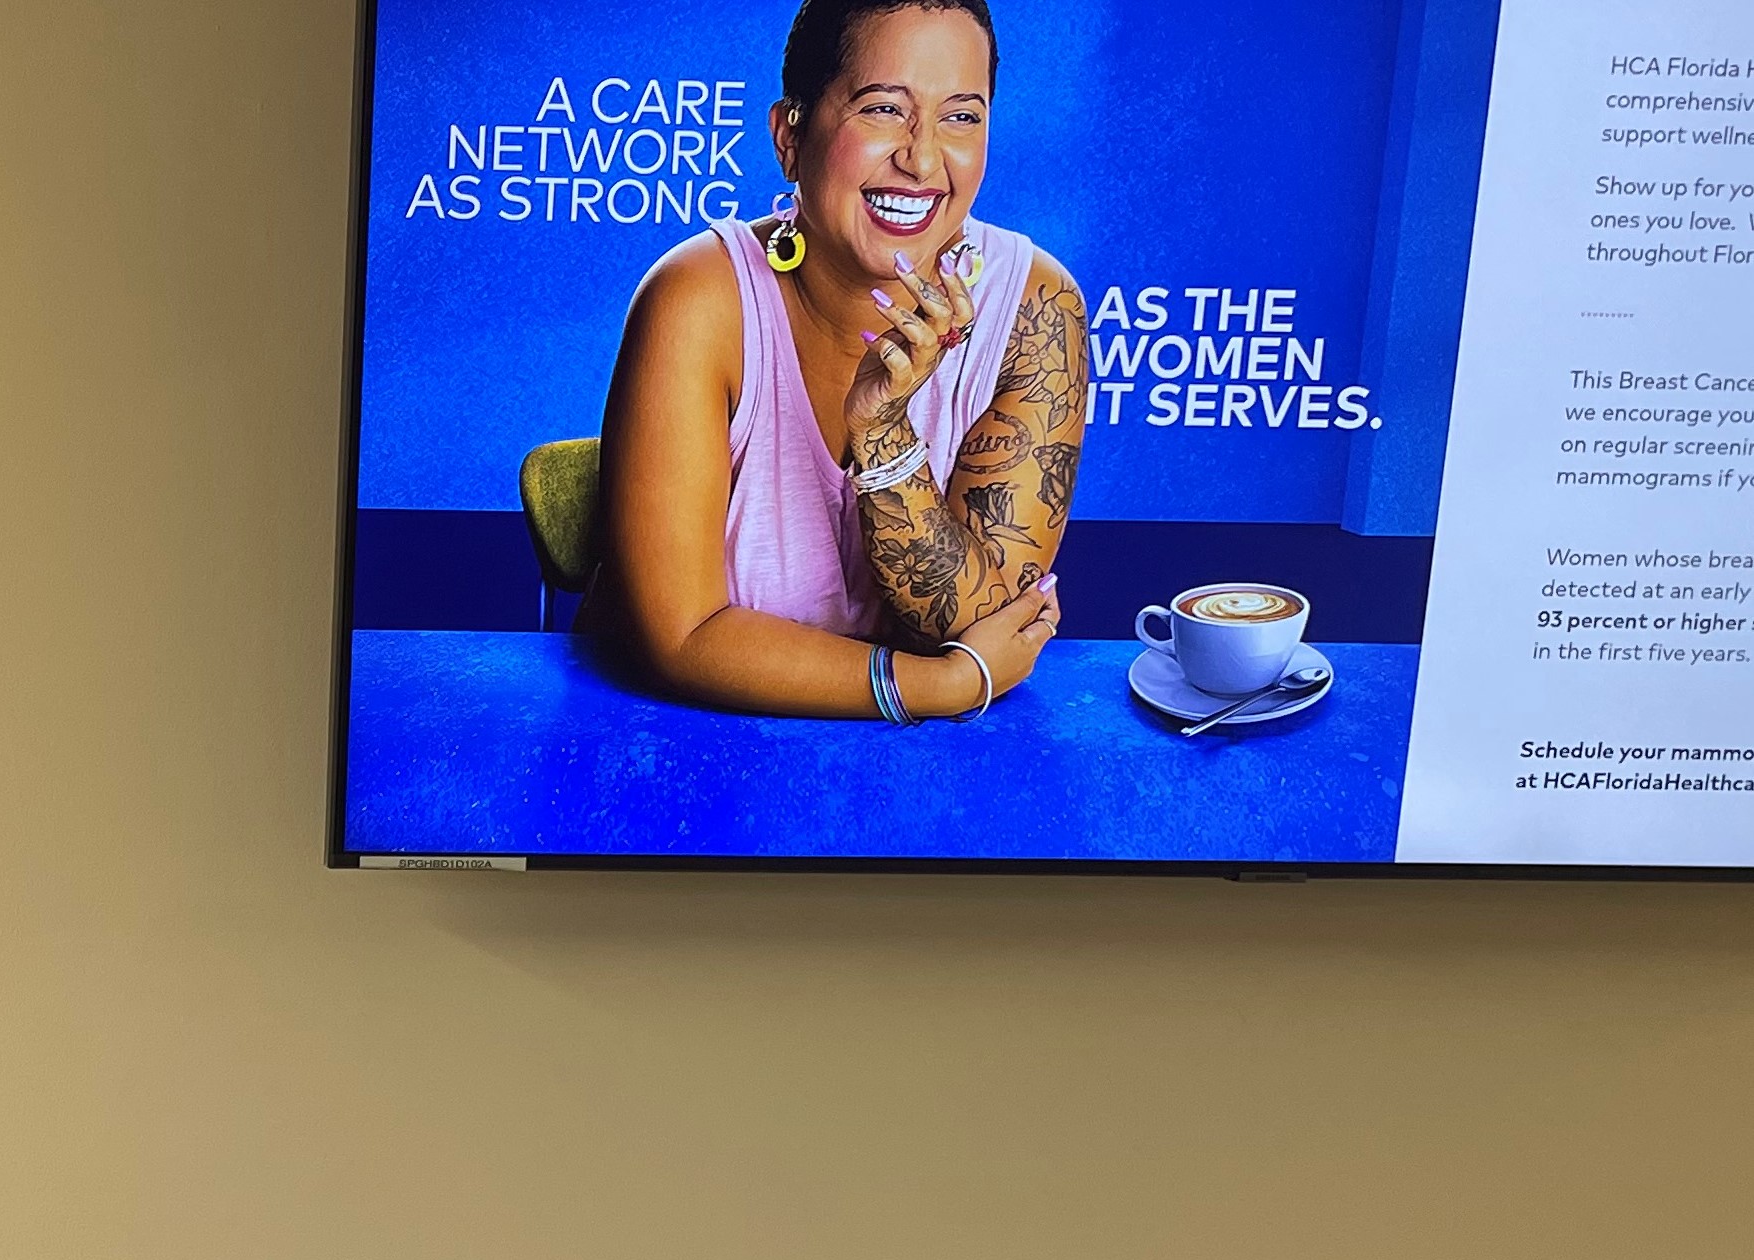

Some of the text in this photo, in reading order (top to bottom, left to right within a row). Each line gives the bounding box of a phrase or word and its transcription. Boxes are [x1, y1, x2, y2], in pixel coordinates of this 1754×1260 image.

[1612, 56, 1660, 75] HCA
[1668, 57, 1739, 77] Florida
[536, 78, 745, 126] A CARE
[1606, 91, 1754, 113] comprehensiv
[1602, 126, 1754, 147] support wellne
[449, 121, 745, 176] NETWORK
[406, 175, 739, 224] AS STRONG
[1596, 176, 1754, 201] Show up for yo
[1591, 215, 1640, 228] ones
[1646, 216, 1683, 233] you
[1690, 211, 1735, 230] love.
[1588, 242, 1708, 266] throughout
[1091, 287, 1296, 332] AS THE
[1090, 334, 1324, 380] WOMEN
[1571, 370, 1612, 388] This
[1620, 371, 1688, 390] Breast
[1086, 383, 1382, 429] IT SERVES.
[1566, 408, 1595, 420] we
[1603, 408, 1711, 426] encourage
[1561, 436, 1668, 457] on regular
[1557, 472, 1712, 489] mammograms
[1718, 469, 1734, 487] if
[1548, 548, 1754, 569] Women whose brea
[1542, 579, 1751, 603] detected at an early
[1538, 611, 1562, 627] 93
[1567, 614, 1648, 632] percent
[1654, 618, 1675, 629] or
[1681, 613, 1746, 634] higher
[1533, 642, 1750, 665] in the first five years.
[1520, 741, 1754, 763] Schedule your mammo
[1516, 774, 1537, 788] at
